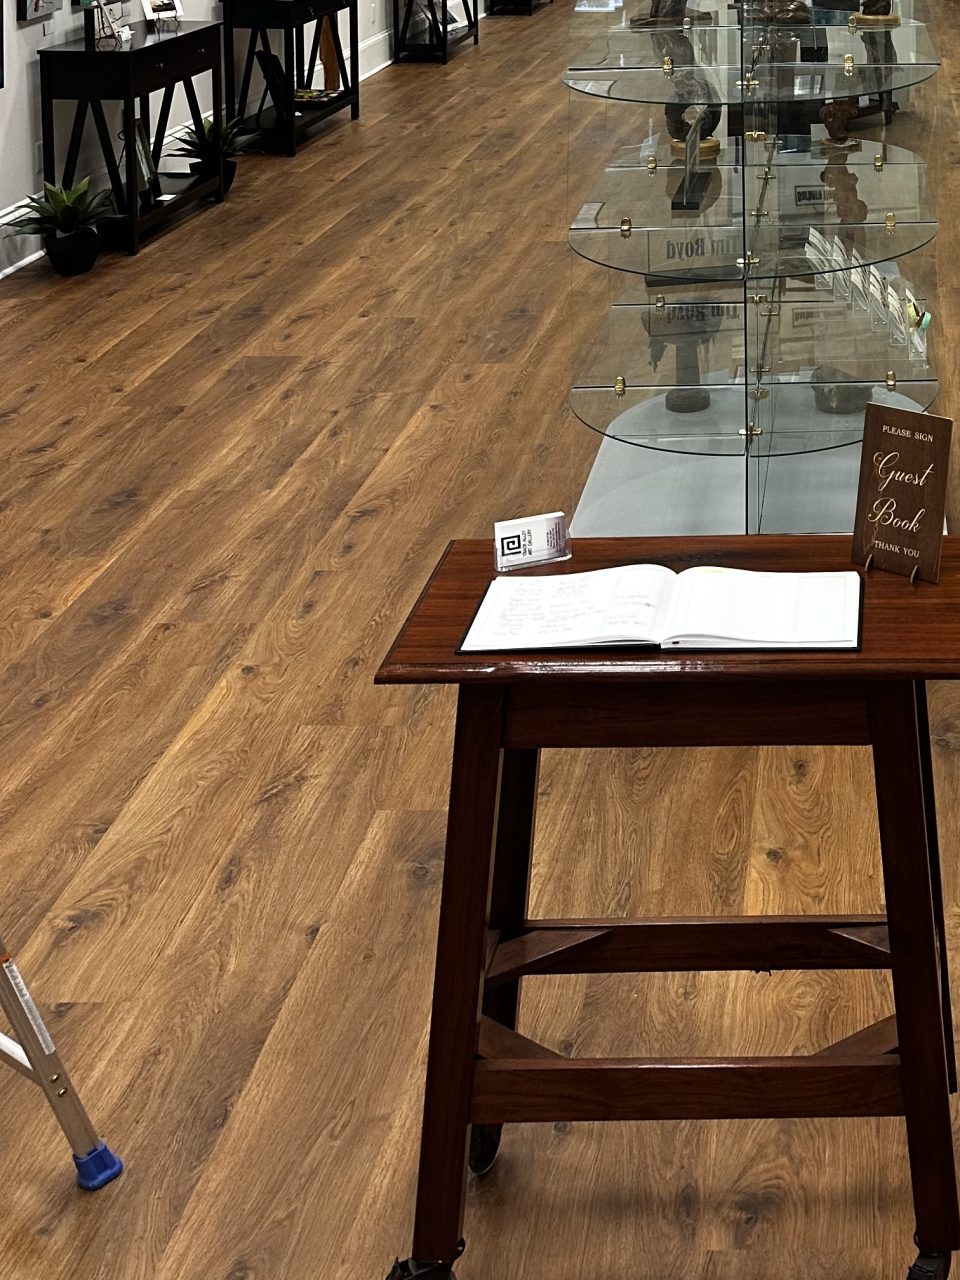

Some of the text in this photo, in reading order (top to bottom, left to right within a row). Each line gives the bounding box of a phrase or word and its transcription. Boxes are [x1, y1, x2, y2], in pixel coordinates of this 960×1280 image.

[882, 424, 934, 443] PLEASE SIGN
[873, 451, 935, 492] Guest
[868, 497, 926, 533] Book
[874, 539, 920, 558] THANK YOU
